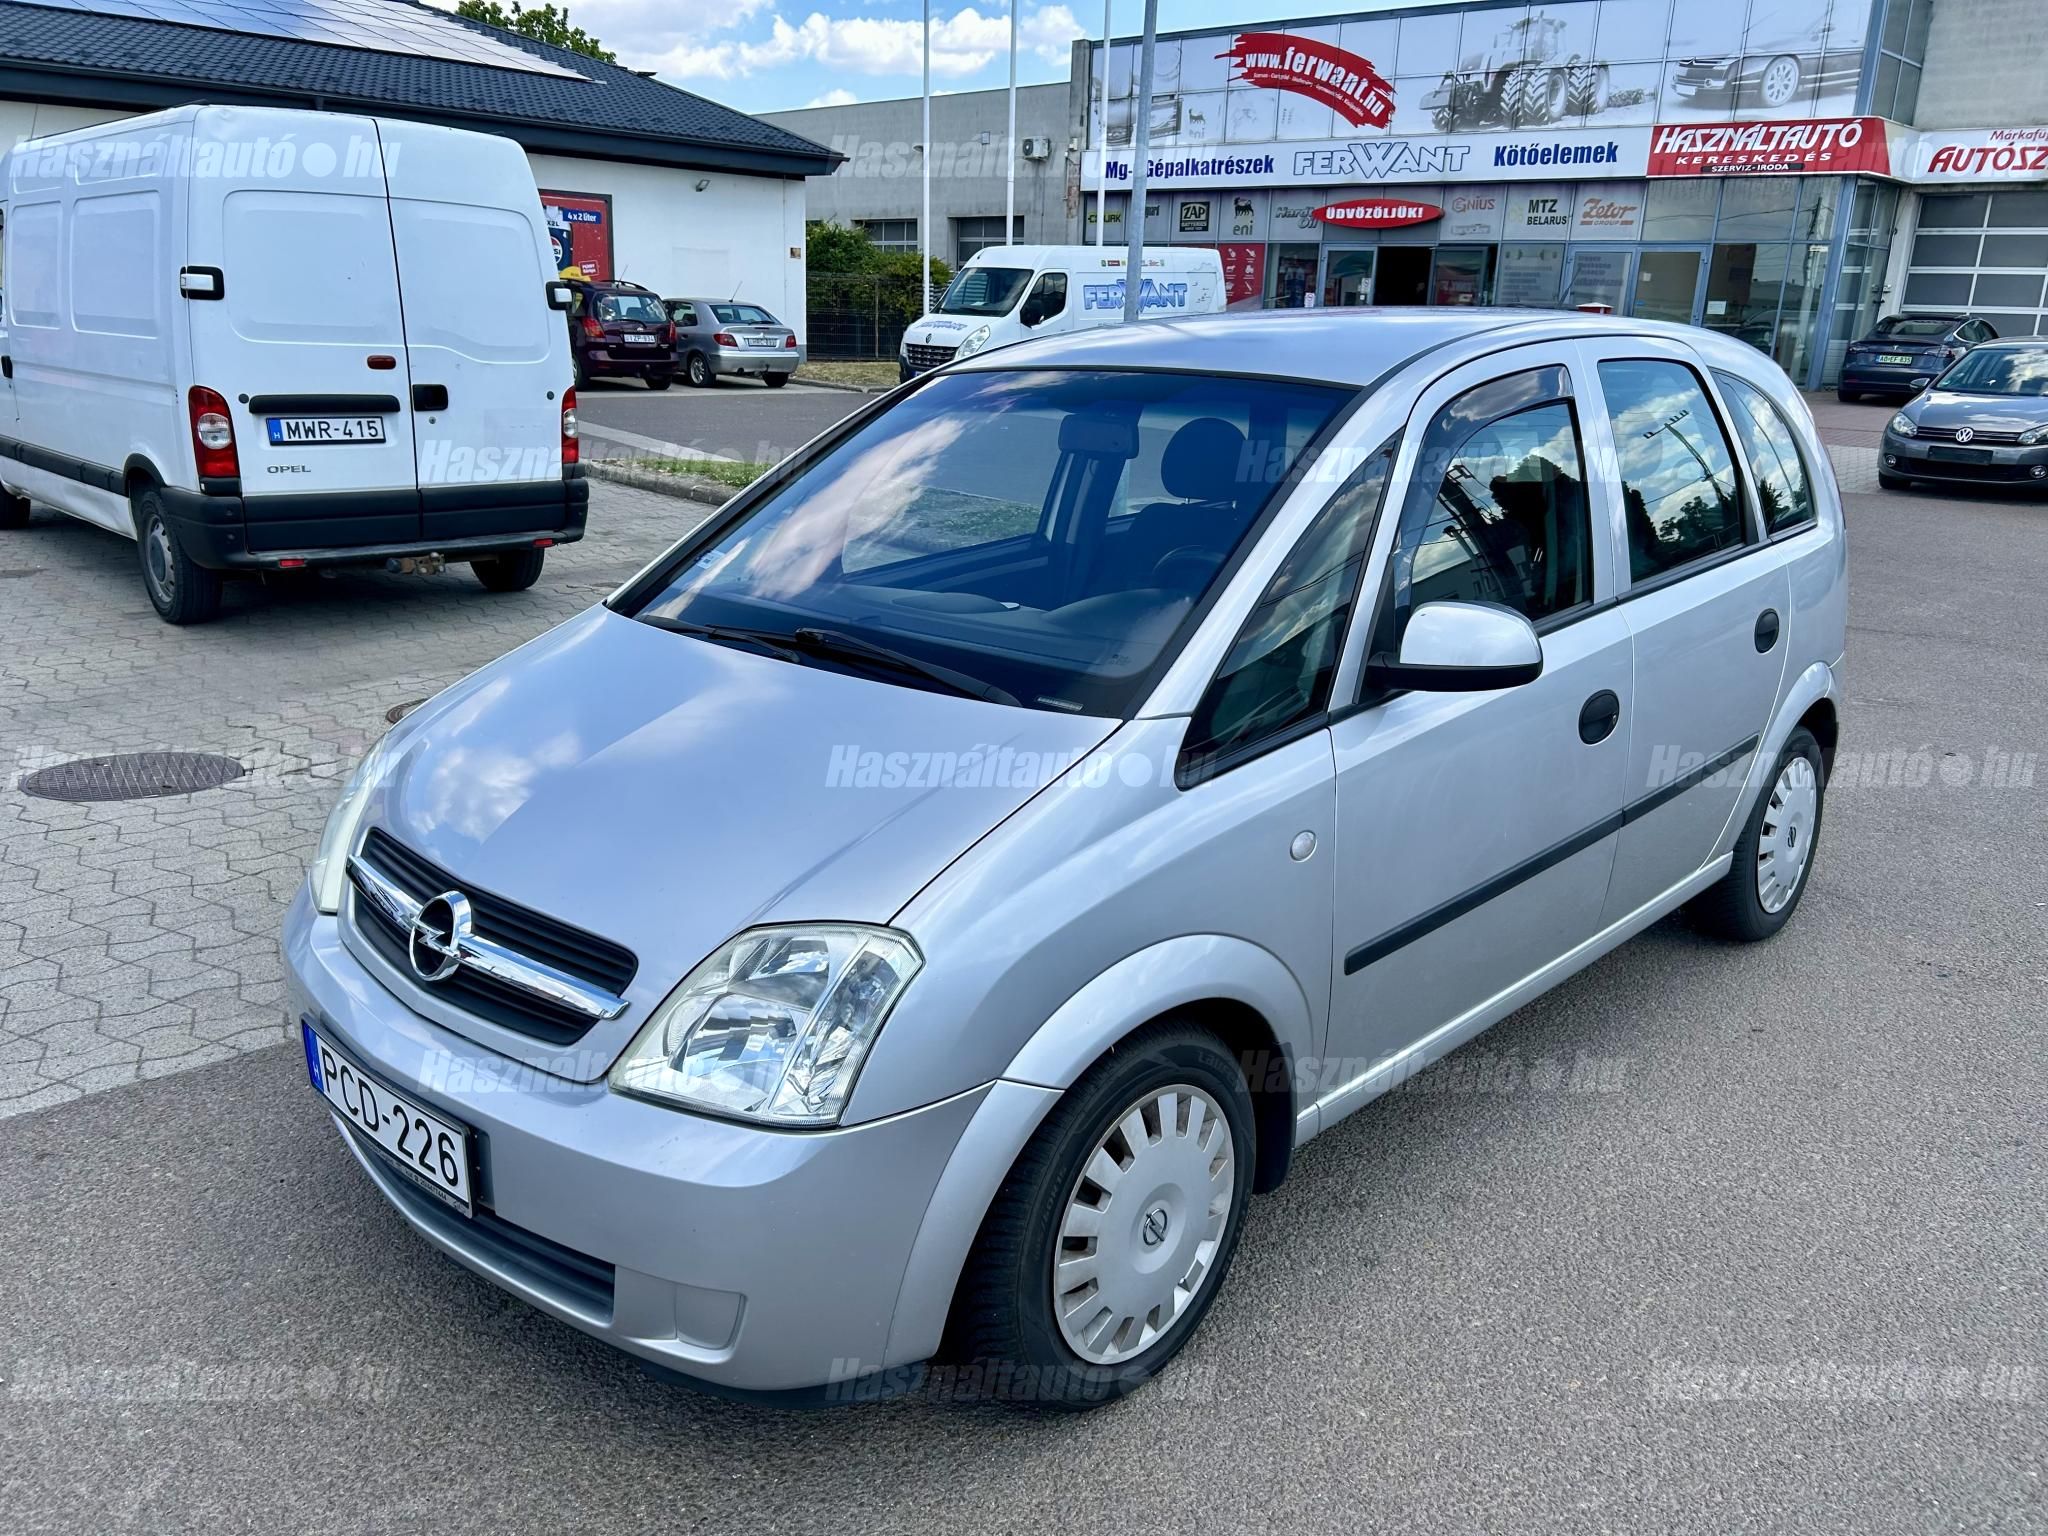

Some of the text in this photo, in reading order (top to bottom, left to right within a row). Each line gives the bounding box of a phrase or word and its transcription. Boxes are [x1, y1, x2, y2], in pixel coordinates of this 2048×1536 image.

[1245, 46, 1384, 117] www.ferwant.hu
[1653, 119, 1863, 154] HASZNÁLTAUTÓ
[1493, 141, 1618, 167] Kötőelemek
[1676, 151, 1833, 165] KERESKEDÉS
[1928, 142, 2048, 174] AUTÓSZ
[1184, 205, 1205, 220] ZAP
[1326, 205, 1423, 219] ÜDVÖZÖLJÜK!
[1528, 199, 1558, 214] MTZ
[1582, 197, 1638, 219] Zetor
[1232, 220, 1254, 236] eni
[1297, 217, 1319, 229] Oil
[1527, 215, 1568, 226] BELARUS
[285, 420, 379, 439] MWR-415
[267, 465, 312, 474] OPEL
[320, 1045, 459, 1188] PCD-226
